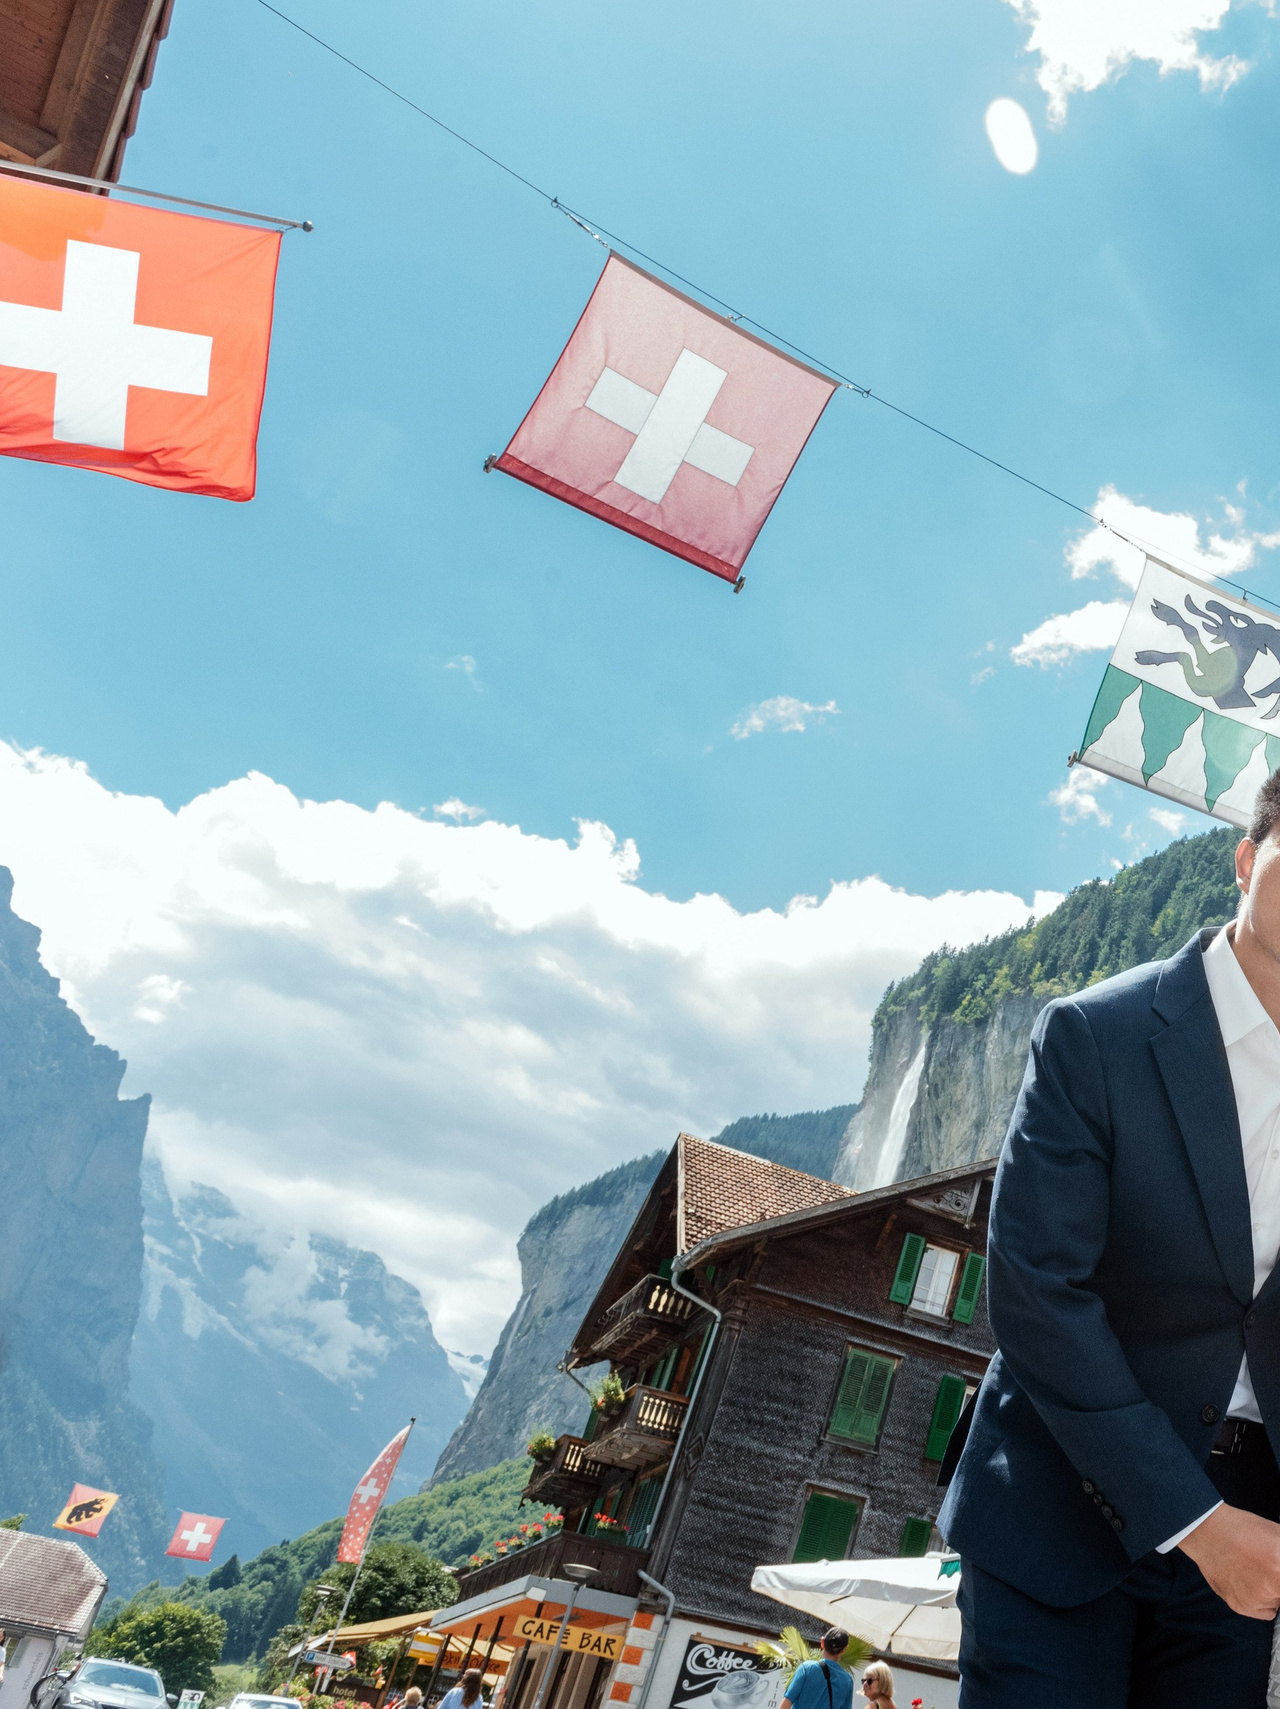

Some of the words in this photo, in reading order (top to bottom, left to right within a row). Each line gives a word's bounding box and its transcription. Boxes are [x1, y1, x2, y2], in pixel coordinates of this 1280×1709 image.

[578, 1632, 617, 1656] BAR
[686, 1643, 758, 1676] Coffee
[333, 1685, 357, 1698] hotel
